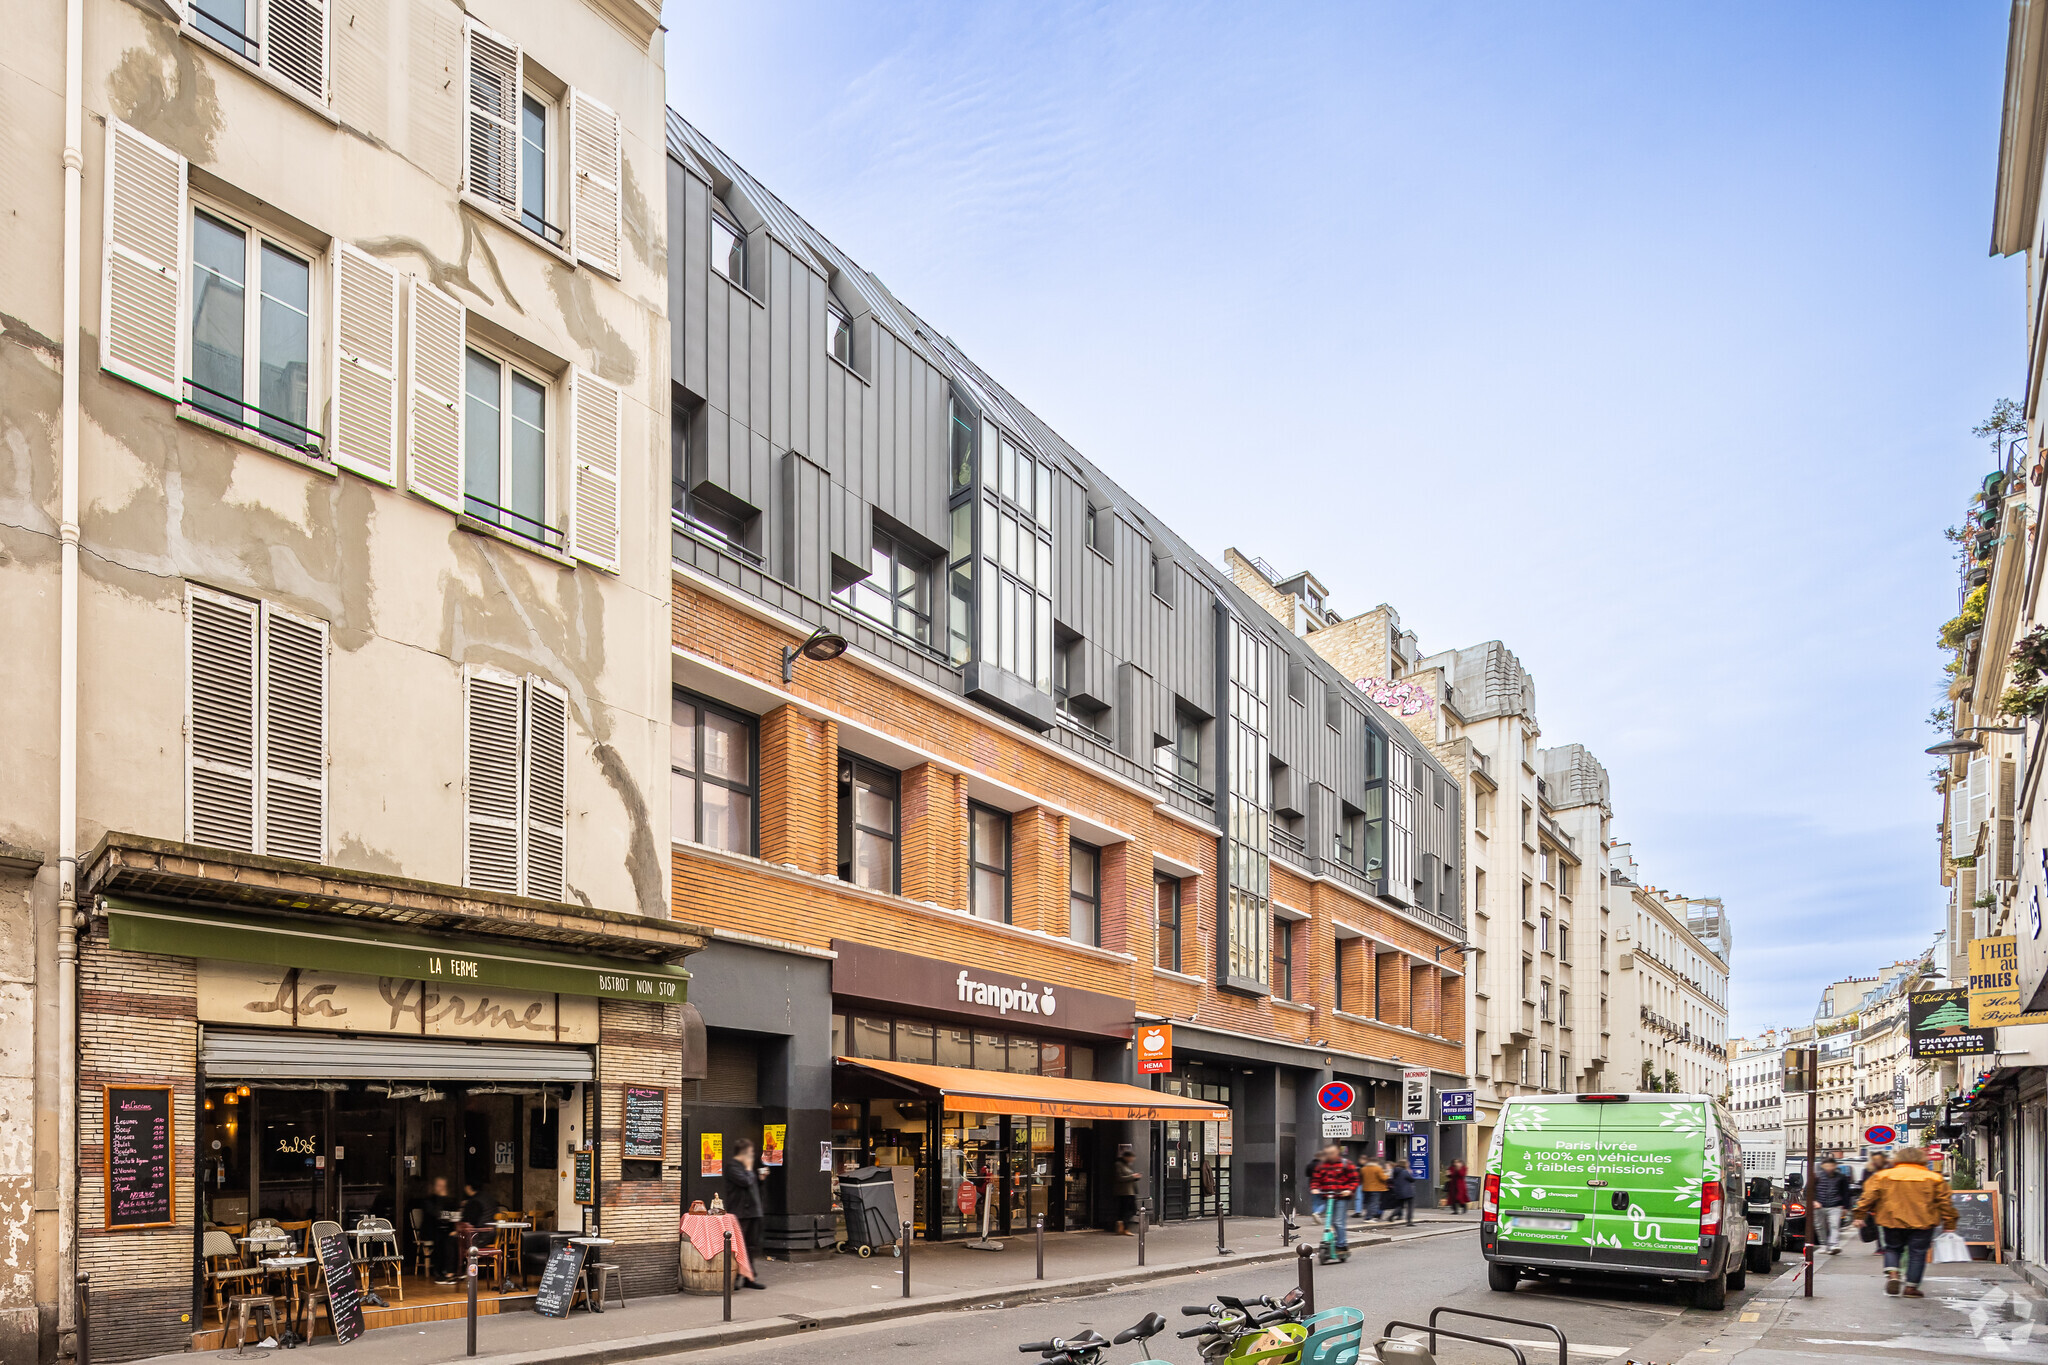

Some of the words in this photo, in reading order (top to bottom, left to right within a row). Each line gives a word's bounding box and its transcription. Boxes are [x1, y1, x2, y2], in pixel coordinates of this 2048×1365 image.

[430, 957, 442, 975] LA
[450, 959, 478, 978] FERME
[599, 975, 629, 991] BISTROT
[636, 979, 652, 995] NON
[659, 982, 676, 997] STOP
[1970, 972, 2012, 990] PERLES
[957, 970, 1039, 1015] franprix
[244, 968, 348, 1017] La
[379, 975, 570, 1033] Ferme
[1919, 1035, 1983, 1044] CHAWARMA
[1920, 1041, 1983, 1050] FALAFEL
[1408, 1081, 1423, 1115] NEW
[1455, 1096, 1464, 1105] P
[1412, 1137, 1426, 1151] P
[1555, 1140, 1591, 1150] Paris
[1595, 1140, 1637, 1151] livrée
[1523, 1151, 1531, 1160] à
[1534, 1151, 1573, 1161] 100%
[1577, 1154, 1595, 1162] en
[1598, 1152, 1672, 1163] véhicules
[1525, 1162, 1533, 1171] à
[1536, 1162, 1584, 1173] faibles
[1587, 1163, 1664, 1175] émissions
[1522, 1205, 1566, 1213] Prestataire
[1513, 1231, 1568, 1240] chronopost.fr
